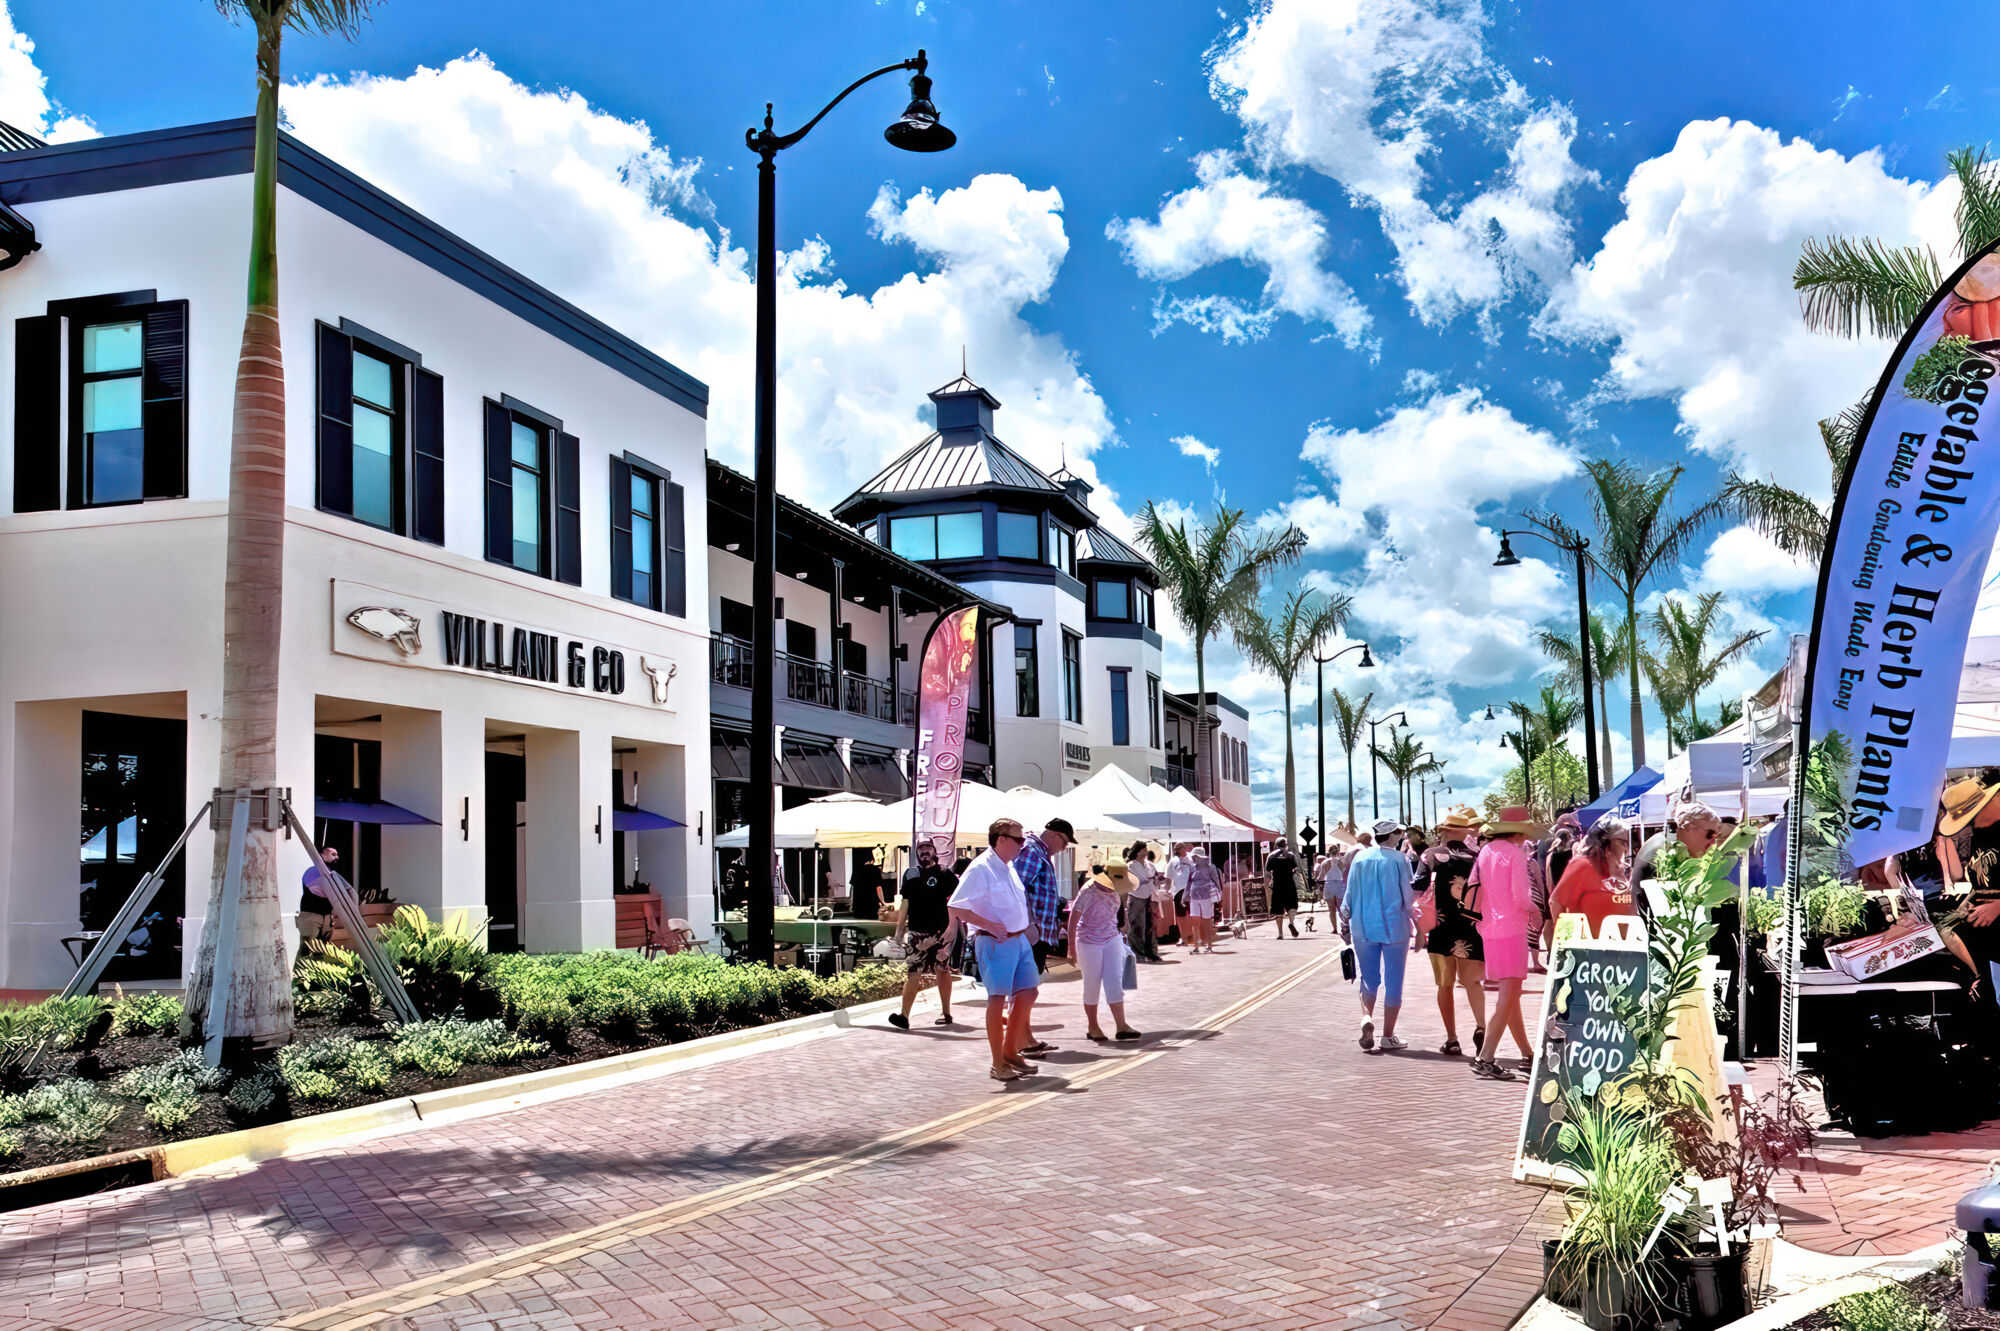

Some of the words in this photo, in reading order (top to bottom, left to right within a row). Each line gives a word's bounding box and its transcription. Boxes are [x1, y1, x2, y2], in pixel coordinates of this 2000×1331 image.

[1852, 499, 1902, 590] Gardening
[1901, 533, 1953, 569] &
[441, 610, 559, 684] VILLANI
[567, 641, 586, 689] &
[592, 645, 625, 695] CO
[1844, 601, 1876, 658] Made
[1877, 582, 1942, 690] Herb
[1832, 668, 1865, 711] Easy
[1848, 702, 1916, 832] Plants
[1576, 961, 1638, 987] GROW
[1582, 1017, 1627, 1043] OWN
[1569, 1040, 1624, 1073] FOOD
